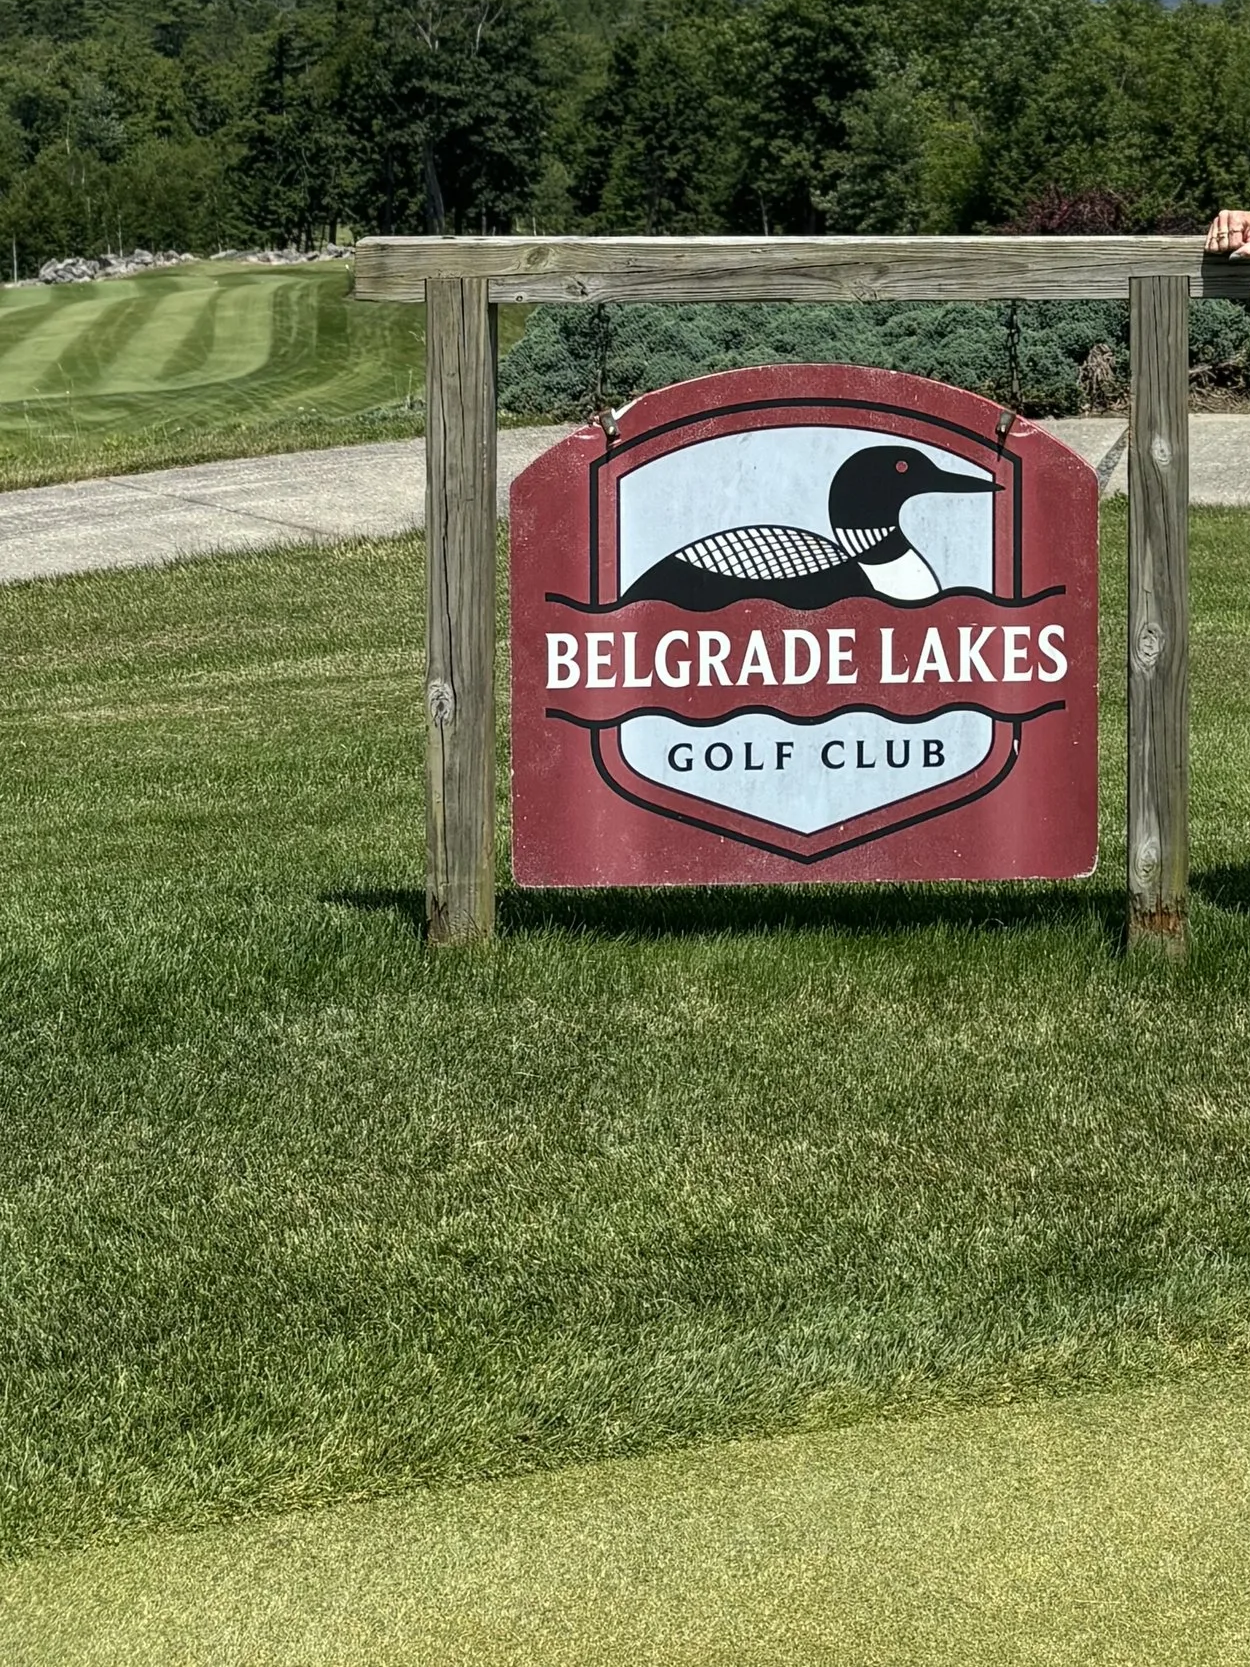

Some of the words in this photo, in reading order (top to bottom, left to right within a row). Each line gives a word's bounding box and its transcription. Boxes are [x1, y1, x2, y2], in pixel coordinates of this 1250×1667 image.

[545, 628, 859, 689] BELGRADE
[879, 624, 1068, 685] LAKES
[667, 741, 794, 772] GOLF
[821, 739, 946, 770] CLUB
